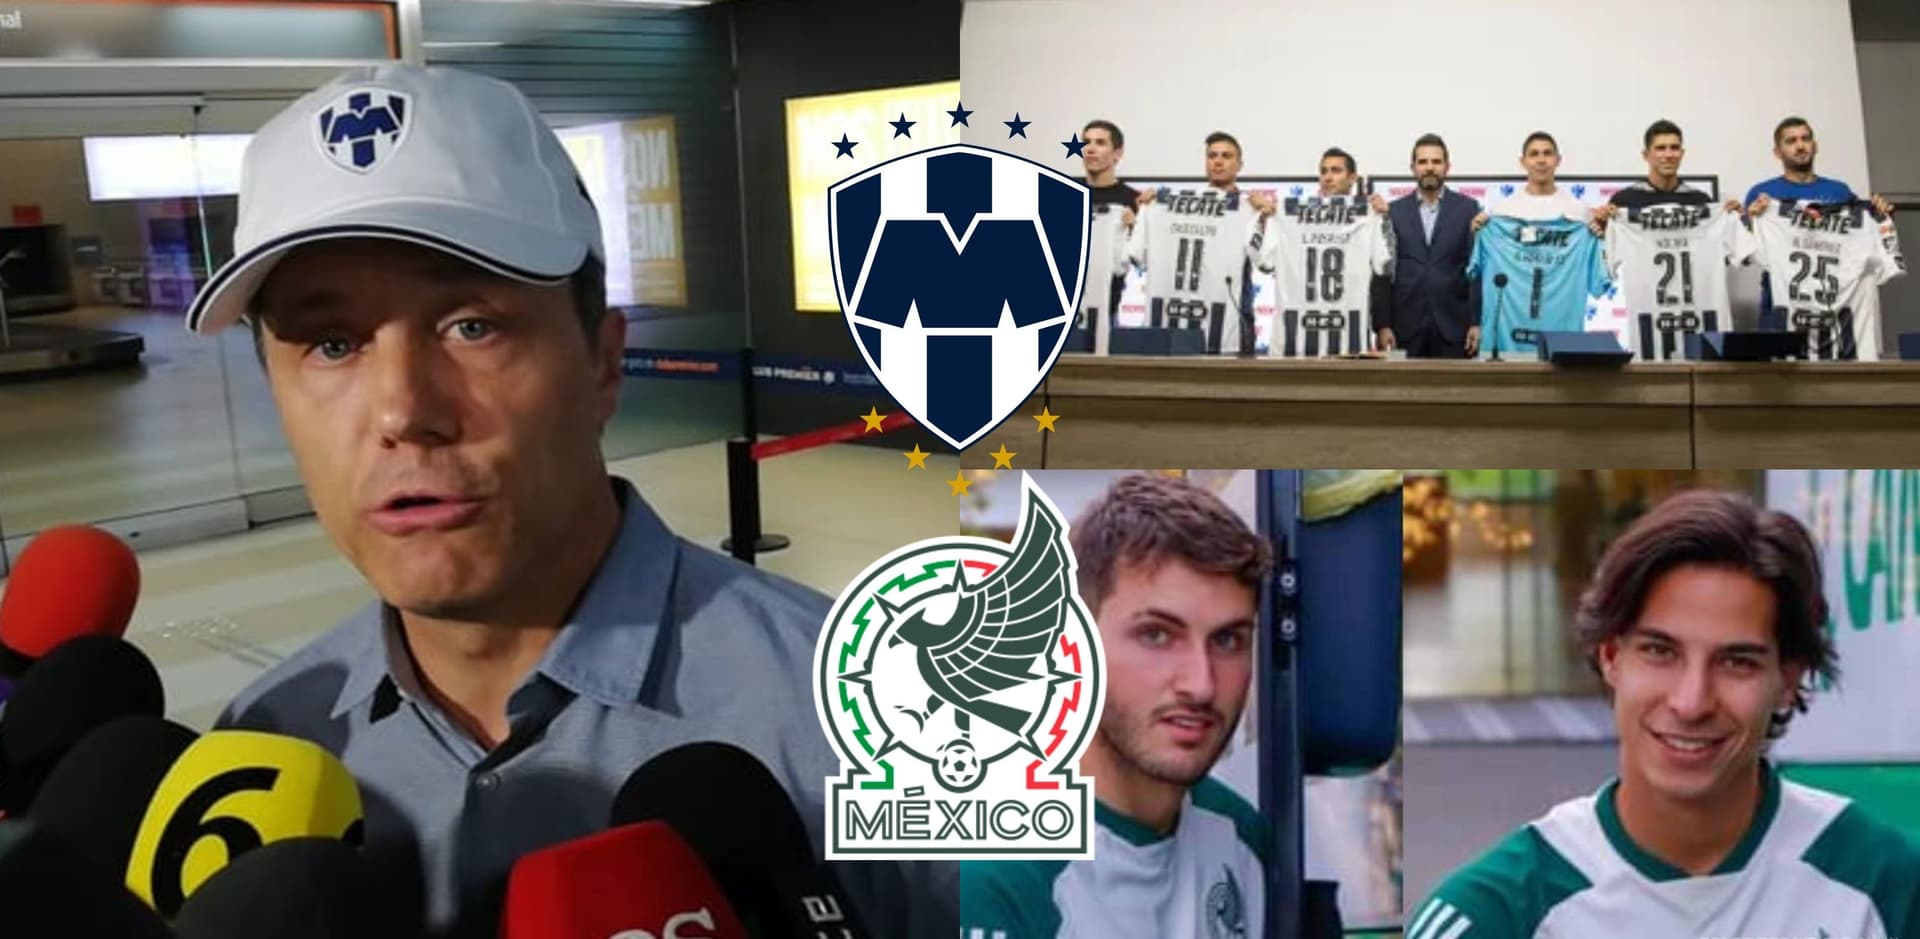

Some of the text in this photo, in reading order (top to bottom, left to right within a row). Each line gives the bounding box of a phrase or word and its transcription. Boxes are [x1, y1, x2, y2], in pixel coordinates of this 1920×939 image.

[1167, 194, 1227, 216] TECATE
[1297, 204, 1357, 224] TECATE
[1640, 211, 1700, 230] TECATE
[1174, 238, 1204, 291] 11
[1305, 246, 1345, 302] 18
[1654, 250, 1693, 304] 21
[1788, 250, 1839, 305] 25
[151, 767, 281, 918] 6
